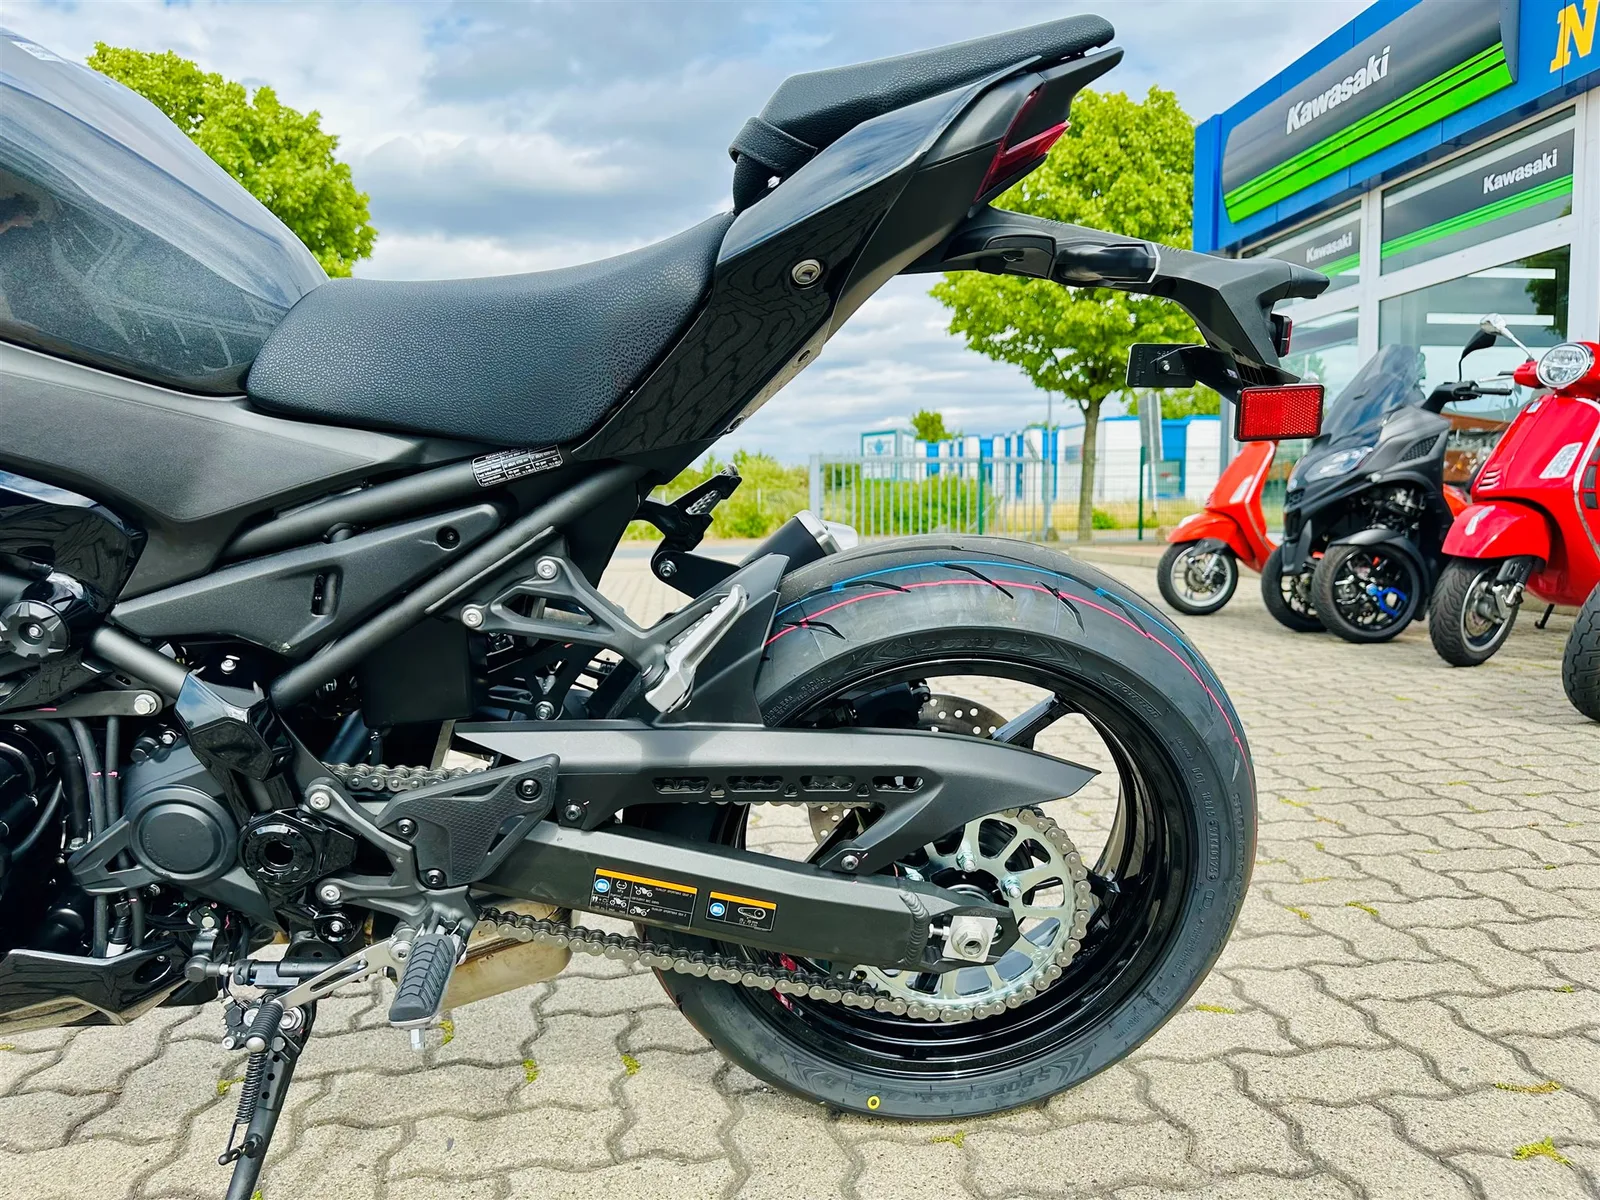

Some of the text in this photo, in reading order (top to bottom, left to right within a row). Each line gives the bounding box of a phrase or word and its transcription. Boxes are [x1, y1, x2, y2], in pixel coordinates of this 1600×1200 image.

[1550, 0, 1600, 73] N
[1286, 45, 1391, 135] Kawasaki
[1483, 148, 1558, 194] Kawasaki
[1306, 231, 1352, 263] Kawasaki
